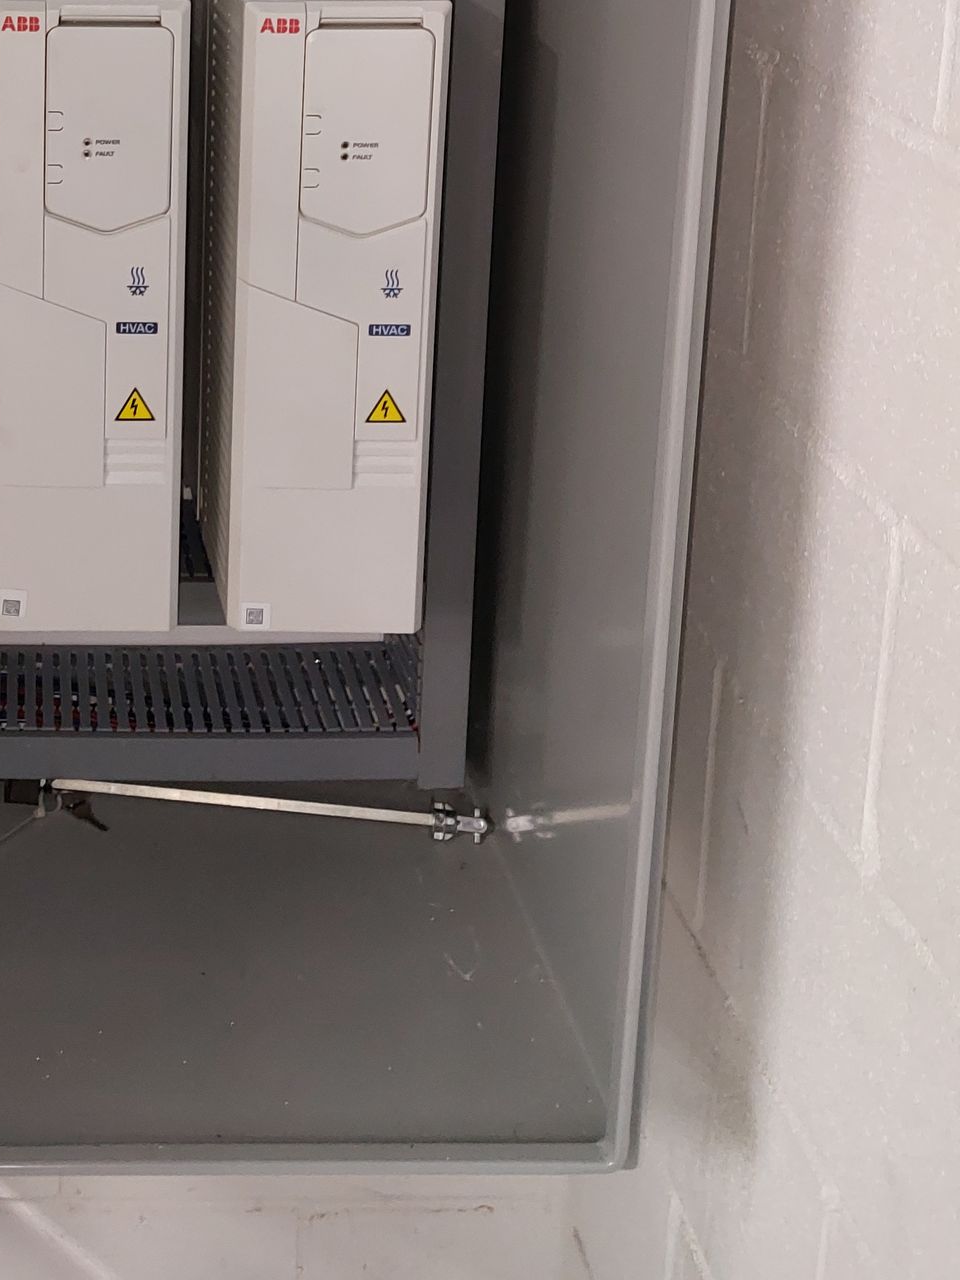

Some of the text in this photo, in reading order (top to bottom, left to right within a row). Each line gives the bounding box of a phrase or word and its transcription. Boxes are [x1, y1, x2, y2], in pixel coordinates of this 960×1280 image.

[1, 16, 41, 32] ABB
[260, 18, 301, 34] ABB
[120, 323, 155, 333] HVAC
[372, 325, 408, 336] HVAC
